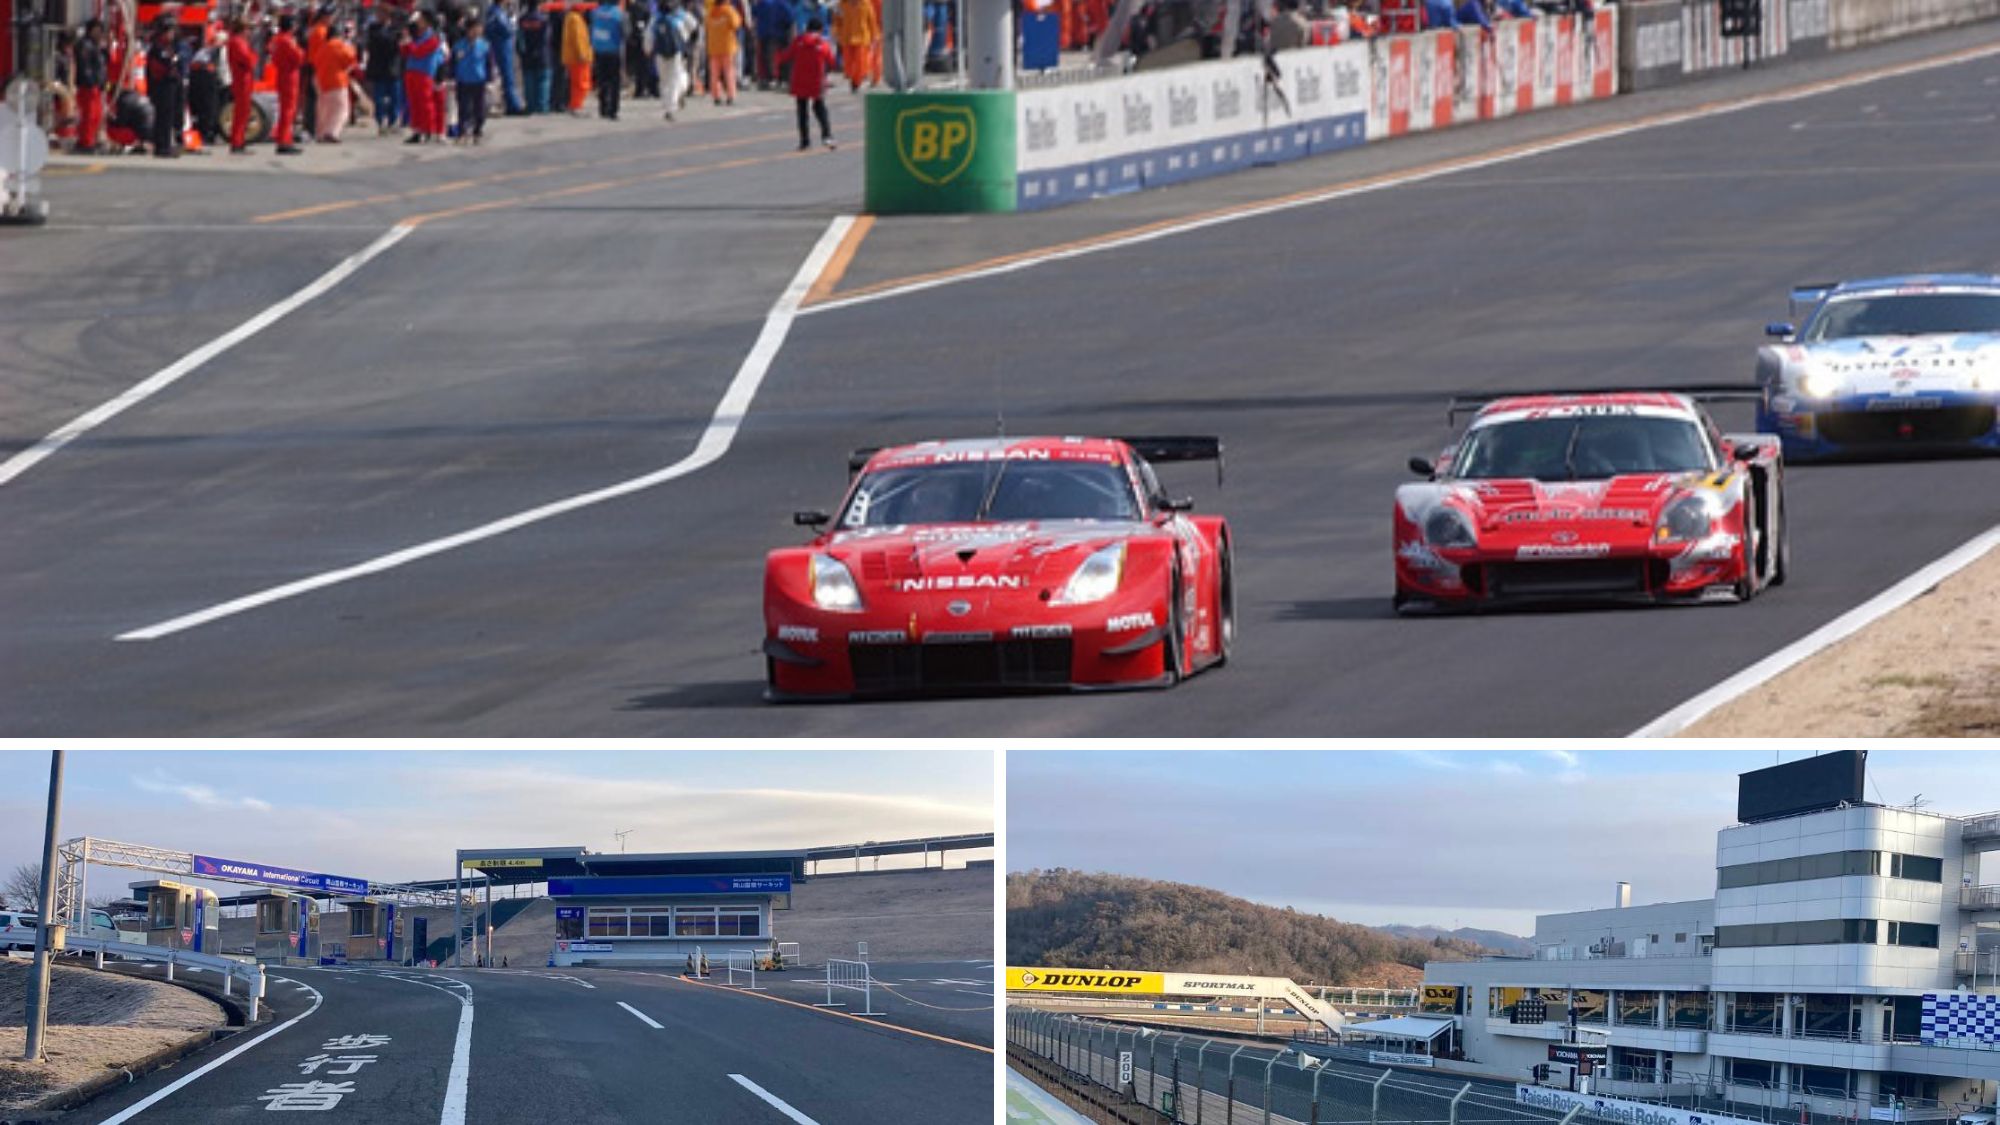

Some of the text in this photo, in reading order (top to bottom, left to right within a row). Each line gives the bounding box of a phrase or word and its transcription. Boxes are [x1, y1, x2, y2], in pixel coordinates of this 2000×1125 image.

[912, 121, 967, 160] BP
[933, 448, 1050, 463] NISSAN
[902, 575, 1020, 592] NISSAN
[1105, 611, 1155, 633] MOTUL
[221, 864, 321, 886] OKAYAMA International Circuit
[1041, 974, 1142, 987] DUNLOP
[1183, 981, 1256, 990] SPORTMAX
[1290, 991, 1320, 1015] DUNLOP
[1122, 1053, 1130, 1081] 200
